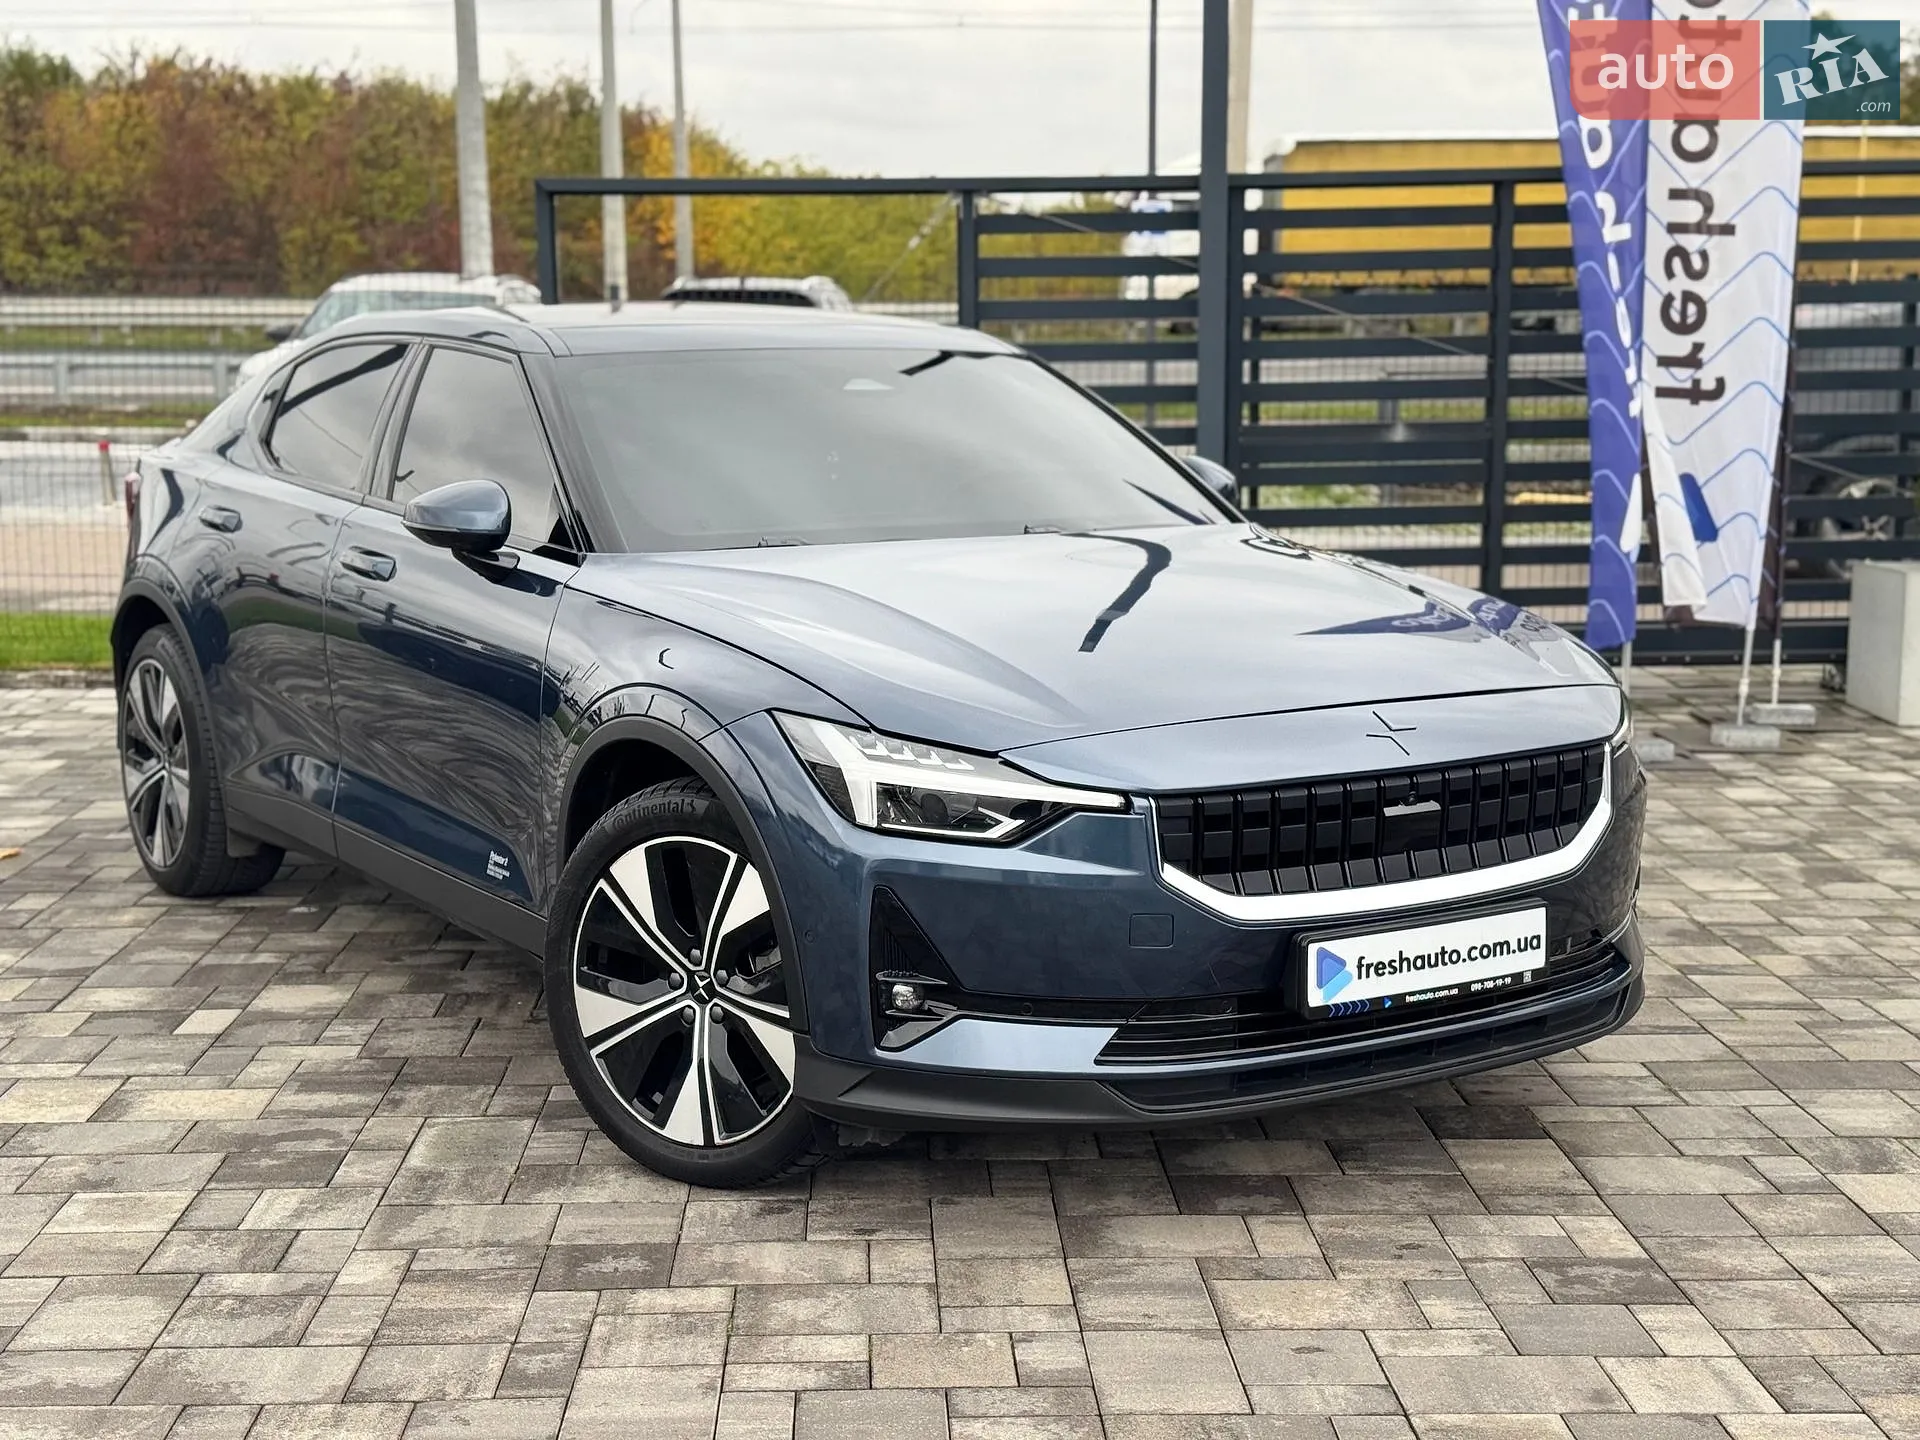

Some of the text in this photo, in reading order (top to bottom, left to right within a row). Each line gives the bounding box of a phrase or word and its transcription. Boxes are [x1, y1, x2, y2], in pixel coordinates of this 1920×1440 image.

[613, 799, 684, 829] Continental
[1356, 933, 1542, 980] freshauto.com.ua
[1405, 988, 1459, 1003] freshauto.com.ua
